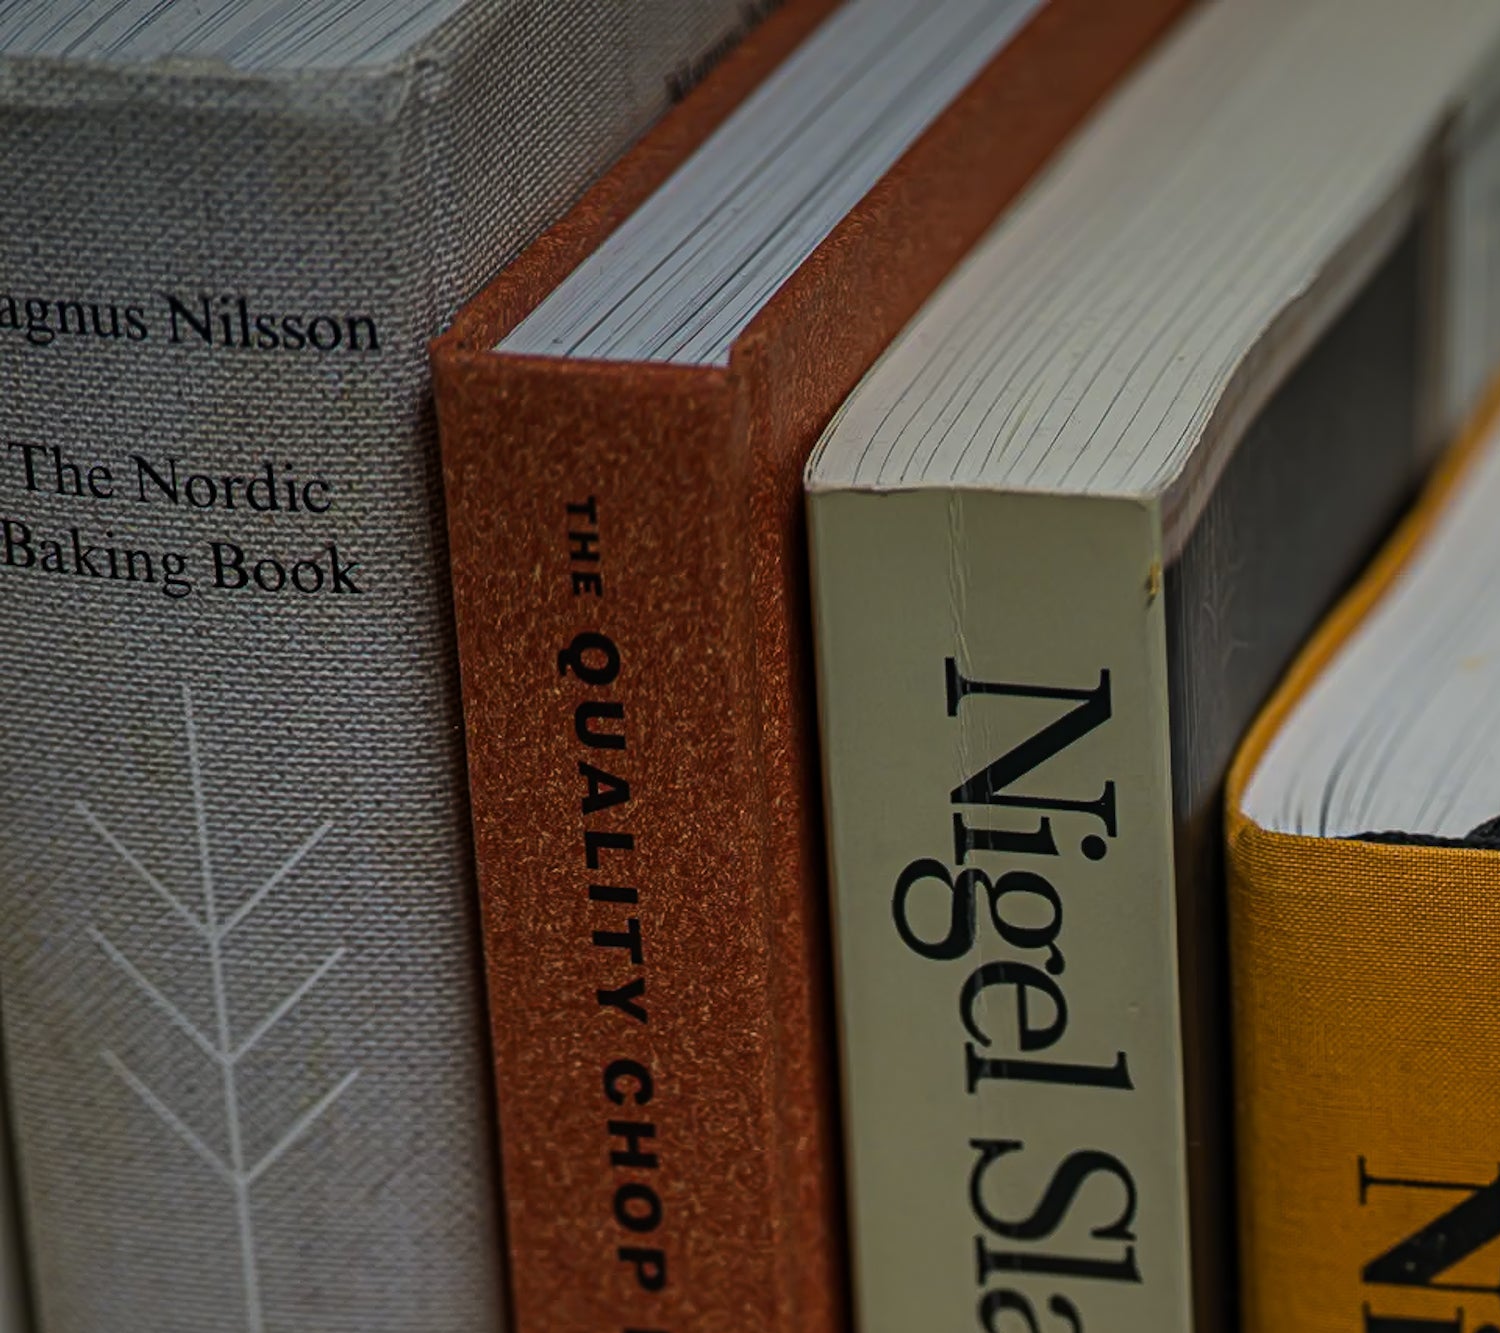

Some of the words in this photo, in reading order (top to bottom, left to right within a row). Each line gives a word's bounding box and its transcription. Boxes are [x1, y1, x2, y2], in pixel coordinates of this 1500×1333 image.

[0, 293, 148, 345] agnus
[162, 294, 380, 352] Nilsson
[8, 442, 114, 500] The
[130, 454, 332, 513] Nordic
[1, 518, 192, 600] Baking
[210, 541, 363, 595] Book
[565, 497, 602, 597] THE
[557, 631, 649, 1024] QUALITY
[891, 657, 1135, 1095] Nigel
[603, 1058, 668, 1294] CHOP
